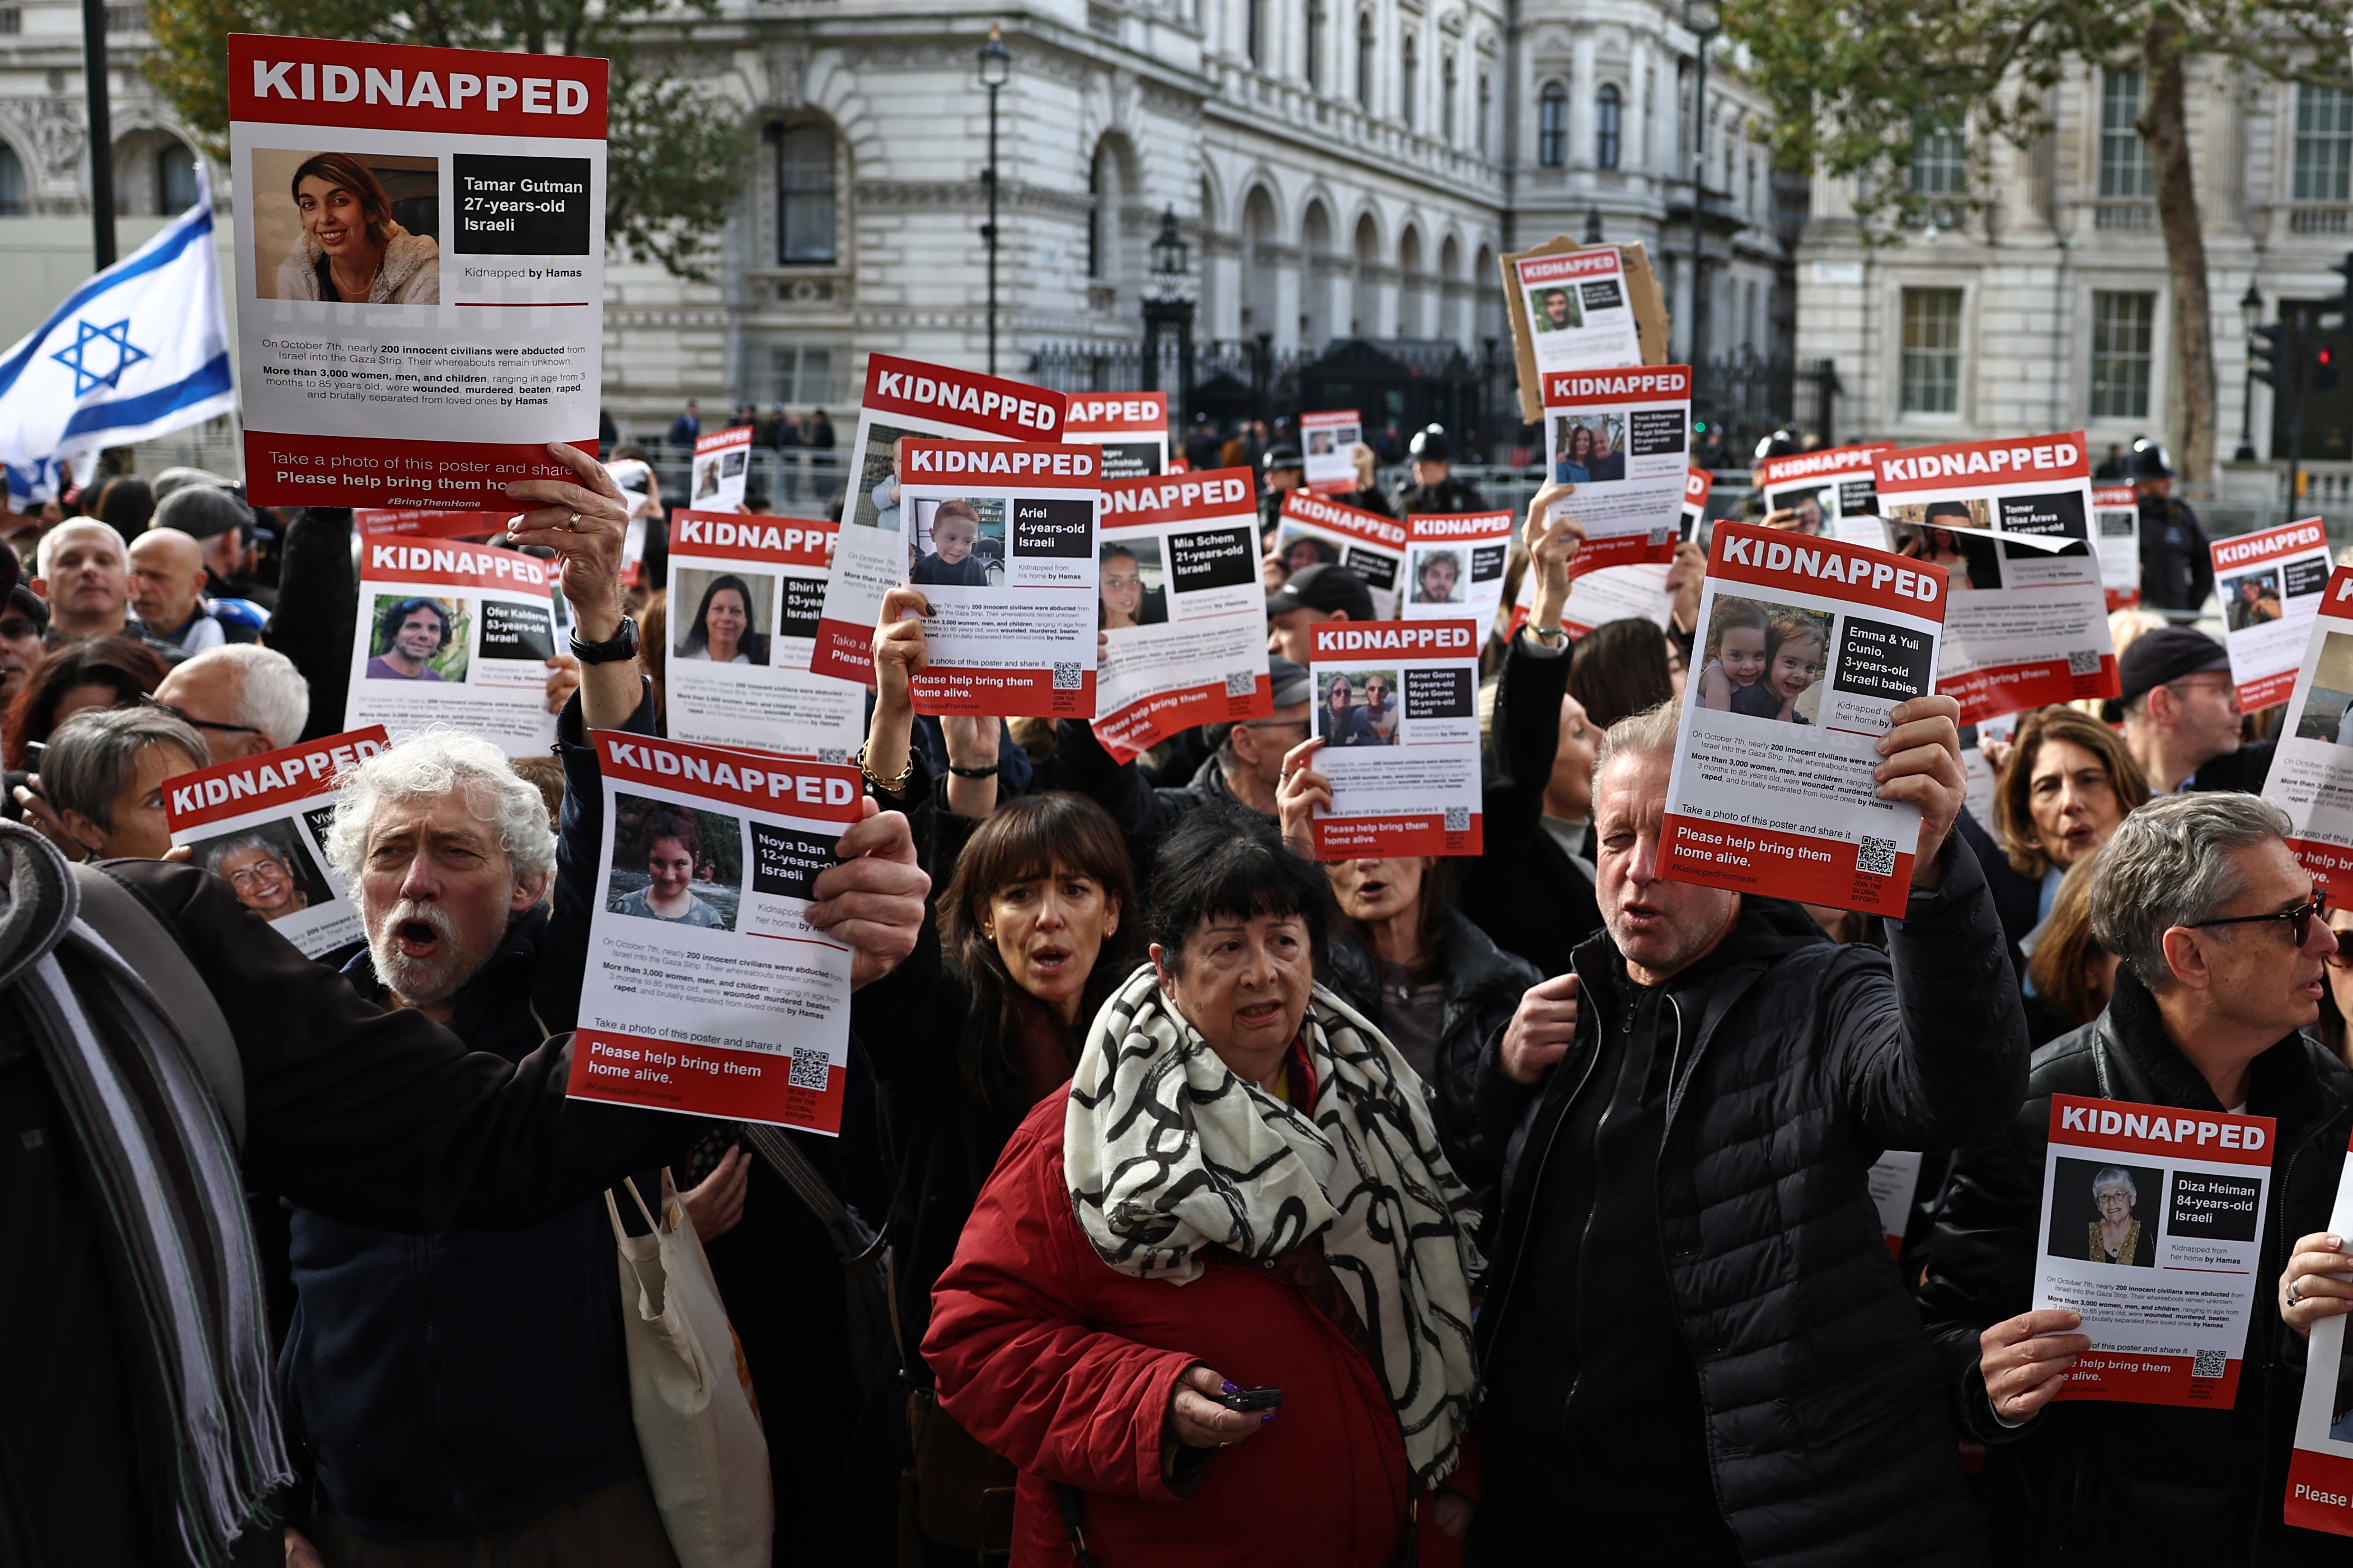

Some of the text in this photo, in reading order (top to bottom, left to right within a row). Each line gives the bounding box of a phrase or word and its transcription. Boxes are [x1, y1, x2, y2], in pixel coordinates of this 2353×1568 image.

[253, 60, 589, 115] KIDNAPPED
[464, 177, 583, 193] Tamar Gutman
[464, 197, 565, 214] 27-years-old
[465, 217, 514, 231] Israeli
[465, 267, 582, 280] Kidnapped by Hamas
[1524, 256, 1614, 278] KIDNAPPED
[262, 338, 278, 348] On
[280, 340, 323, 350] October
[326, 342, 344, 352] 7th,
[347, 344, 378, 354] nearly
[381, 345, 400, 354] 200
[402, 346, 448, 355] innocent
[450, 347, 492, 355] civilians
[522, 346, 565, 355] abducted
[1554, 374, 1685, 397] KIDNAPPED
[877, 370, 1056, 431] KIDNAPPED
[268, 451, 572, 476] Take a photo of this poster and share
[912, 450, 1093, 475] KIDNAPPED
[1769, 449, 1872, 479] KIDNAPPE
[1882, 444, 2078, 482] KIDNAPPED
[277, 471, 481, 491] Please help bring them
[387, 498, 481, 507] #BringThemHome
[1101, 479, 1246, 517] DNAPPED
[1019, 507, 1047, 518] Ariel
[2004, 505, 2034, 514] Tomer
[1019, 522, 1085, 535] 4-years-old
[1289, 496, 1406, 547] KIDNAPPED
[1413, 515, 1510, 535] KIDNAPPED
[680, 519, 839, 553] KIDNAPPE
[1019, 536, 1055, 547] Israeli
[1174, 534, 1235, 549] Mia Schem
[1176, 544, 1244, 562] 21-years-old
[2216, 526, 2320, 564] KIDNAPPED
[373, 545, 544, 585] KIDNAPPED
[1177, 562, 1211, 575] Israeli
[1722, 535, 1938, 602] KIDNAPPED
[788, 581, 814, 593] Shiri
[788, 594, 822, 608] 53-yea
[487, 606, 509, 618] Ofer
[787, 608, 819, 620] Israeli
[487, 619, 546, 634] 53-years-old
[486, 632, 519, 643] Israeli
[1318, 628, 1470, 651] KIDNAPPED
[1849, 626, 1919, 650] Emma & Yuli
[832, 649, 871, 666] Please
[1847, 641, 1885, 659] Cunio,
[1845, 656, 1909, 677] 3-years-old
[912, 675, 1033, 688] Please help bring them
[1409, 680, 1455, 690] 56-years-old
[1842, 671, 1918, 694] Israeli babies
[913, 687, 971, 698] home alive.
[1409, 690, 1430, 699] Maya
[1410, 698, 1455, 708] 56-years-old
[1837, 700, 1881, 715] Kidnapped
[1835, 712, 1890, 729] their home by
[608, 740, 854, 806] KIDNAPPED
[1324, 821, 1429, 834] Please help bring them
[1682, 803, 1703, 815] Take
[1713, 810, 1739, 821] photo
[1740, 814, 1750, 823] of
[1751, 816, 1768, 826] this
[1769, 820, 1798, 830] poster
[1799, 825, 1816, 834] and
[1818, 827, 1843, 838] share
[1845, 831, 1851, 840] it
[759, 833, 826, 855] Noya Dan
[1325, 835, 1377, 845] home alive.
[1677, 826, 1831, 862] Please help bring them
[761, 848, 836, 869] 12-years-o
[1674, 844, 1751, 867] home alive.
[762, 863, 803, 880] Israeli
[1671, 863, 1759, 884] #KidnappedFromIsrael
[1855, 873, 1873, 881] SCAN
[1851, 894, 1880, 905] EFFORTS
[1853, 888, 1878, 897] GLOBAL
[591, 1042, 761, 1077] Please help bring them
[588, 1061, 673, 1084] home alive.
[2061, 1105, 2265, 1150] KIDNAPPED
[2178, 1179, 2255, 1197] Diza Heiman
[2177, 1195, 2253, 1211] 84-years-old
[2175, 1210, 2213, 1223] Israeli
[2171, 1244, 2210, 1254] Kidnapped
[2205, 1256, 2214, 1264] by
[2216, 1256, 2241, 1265] Hamas
[2080, 1358, 2171, 1373] help bring them
[2072, 1371, 2101, 1381] alive.
[2295, 1484, 2347, 1506] Please
